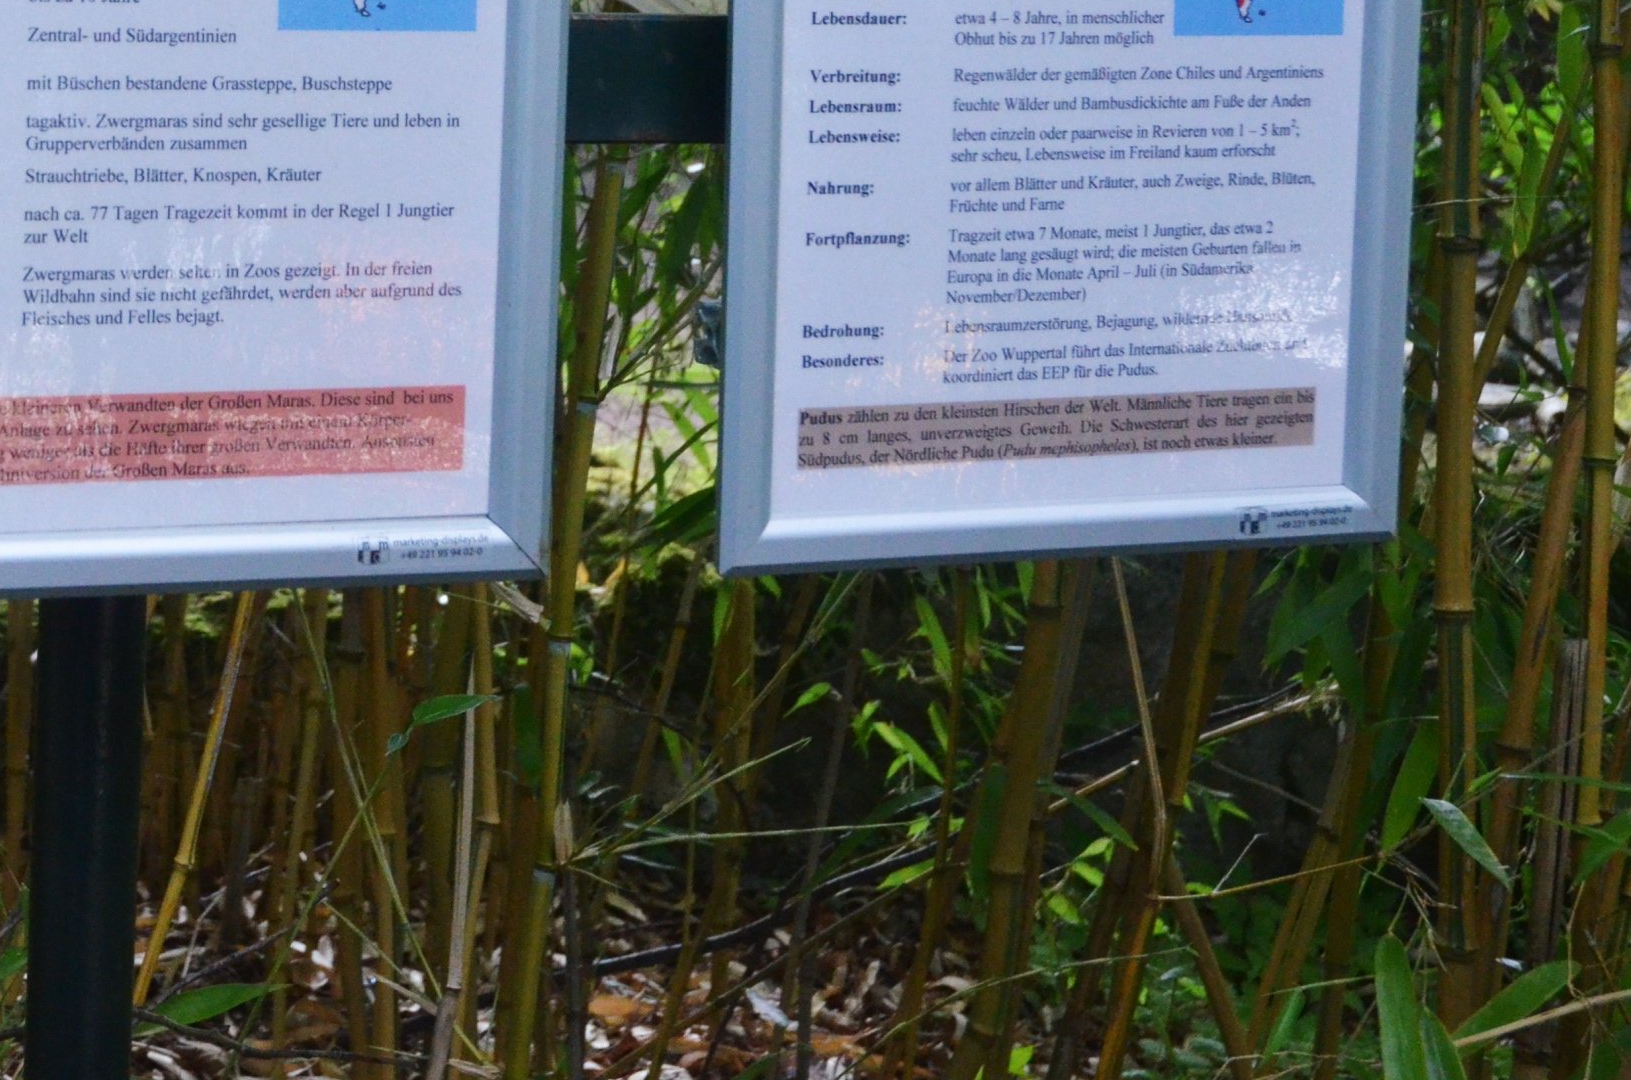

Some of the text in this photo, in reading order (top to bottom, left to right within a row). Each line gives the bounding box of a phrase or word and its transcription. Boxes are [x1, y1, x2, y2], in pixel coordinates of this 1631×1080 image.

[812, 11, 906, 26] Lebensdauer:
[28, 27, 237, 48] Zentral- und Südargentinien
[810, 69, 900, 87] Verbreitung:
[809, 99, 902, 115] Lebensraum:
[170, 138, 247, 151] zusammen
[809, 128, 900, 144] Lebensweise:
[25, 166, 322, 186] Strauchtriebe, Blätter, Knospen, Kräuter
[807, 181, 874, 198] Nahrung:
[949, 197, 1065, 214] Früchte und Farne
[24, 228, 88, 245] zur Welt
[806, 230, 910, 249] Fortpflanzung:
[945, 286, 1087, 306] November/Dezember)
[802, 323, 884, 341] Bedrohung:
[802, 353, 884, 369] Besonderes:
[798, 451, 865, 470] Südpudus,
[869, 448, 891, 464] der
[893, 445, 958, 463] Nördliche
[961, 443, 994, 460] Pudu
[997, 442, 1037, 460] (Pudu
[1144, 436, 1158, 451] ist
[1161, 434, 1191, 450] noch
[1194, 436, 1229, 448] etwas
[1232, 431, 1279, 446] kleiner.
